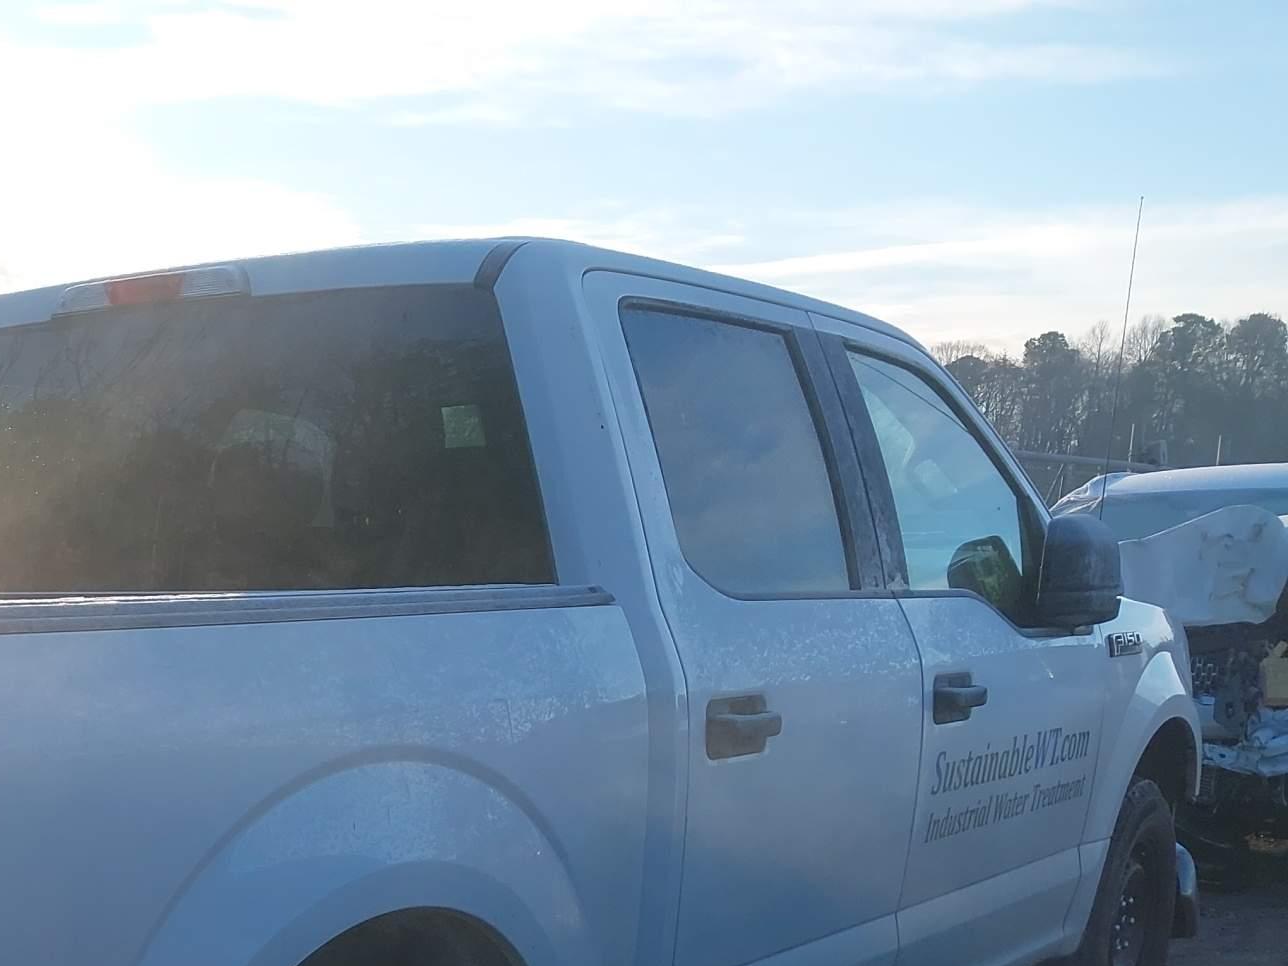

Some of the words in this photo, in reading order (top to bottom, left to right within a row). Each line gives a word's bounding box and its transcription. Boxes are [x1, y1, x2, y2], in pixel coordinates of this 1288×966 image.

[930, 728, 1090, 795] SustainableWT.com
[924, 794, 992, 843] Industrial
[993, 790, 1030, 824] Water
[1030, 776, 1087, 811] Treatment
